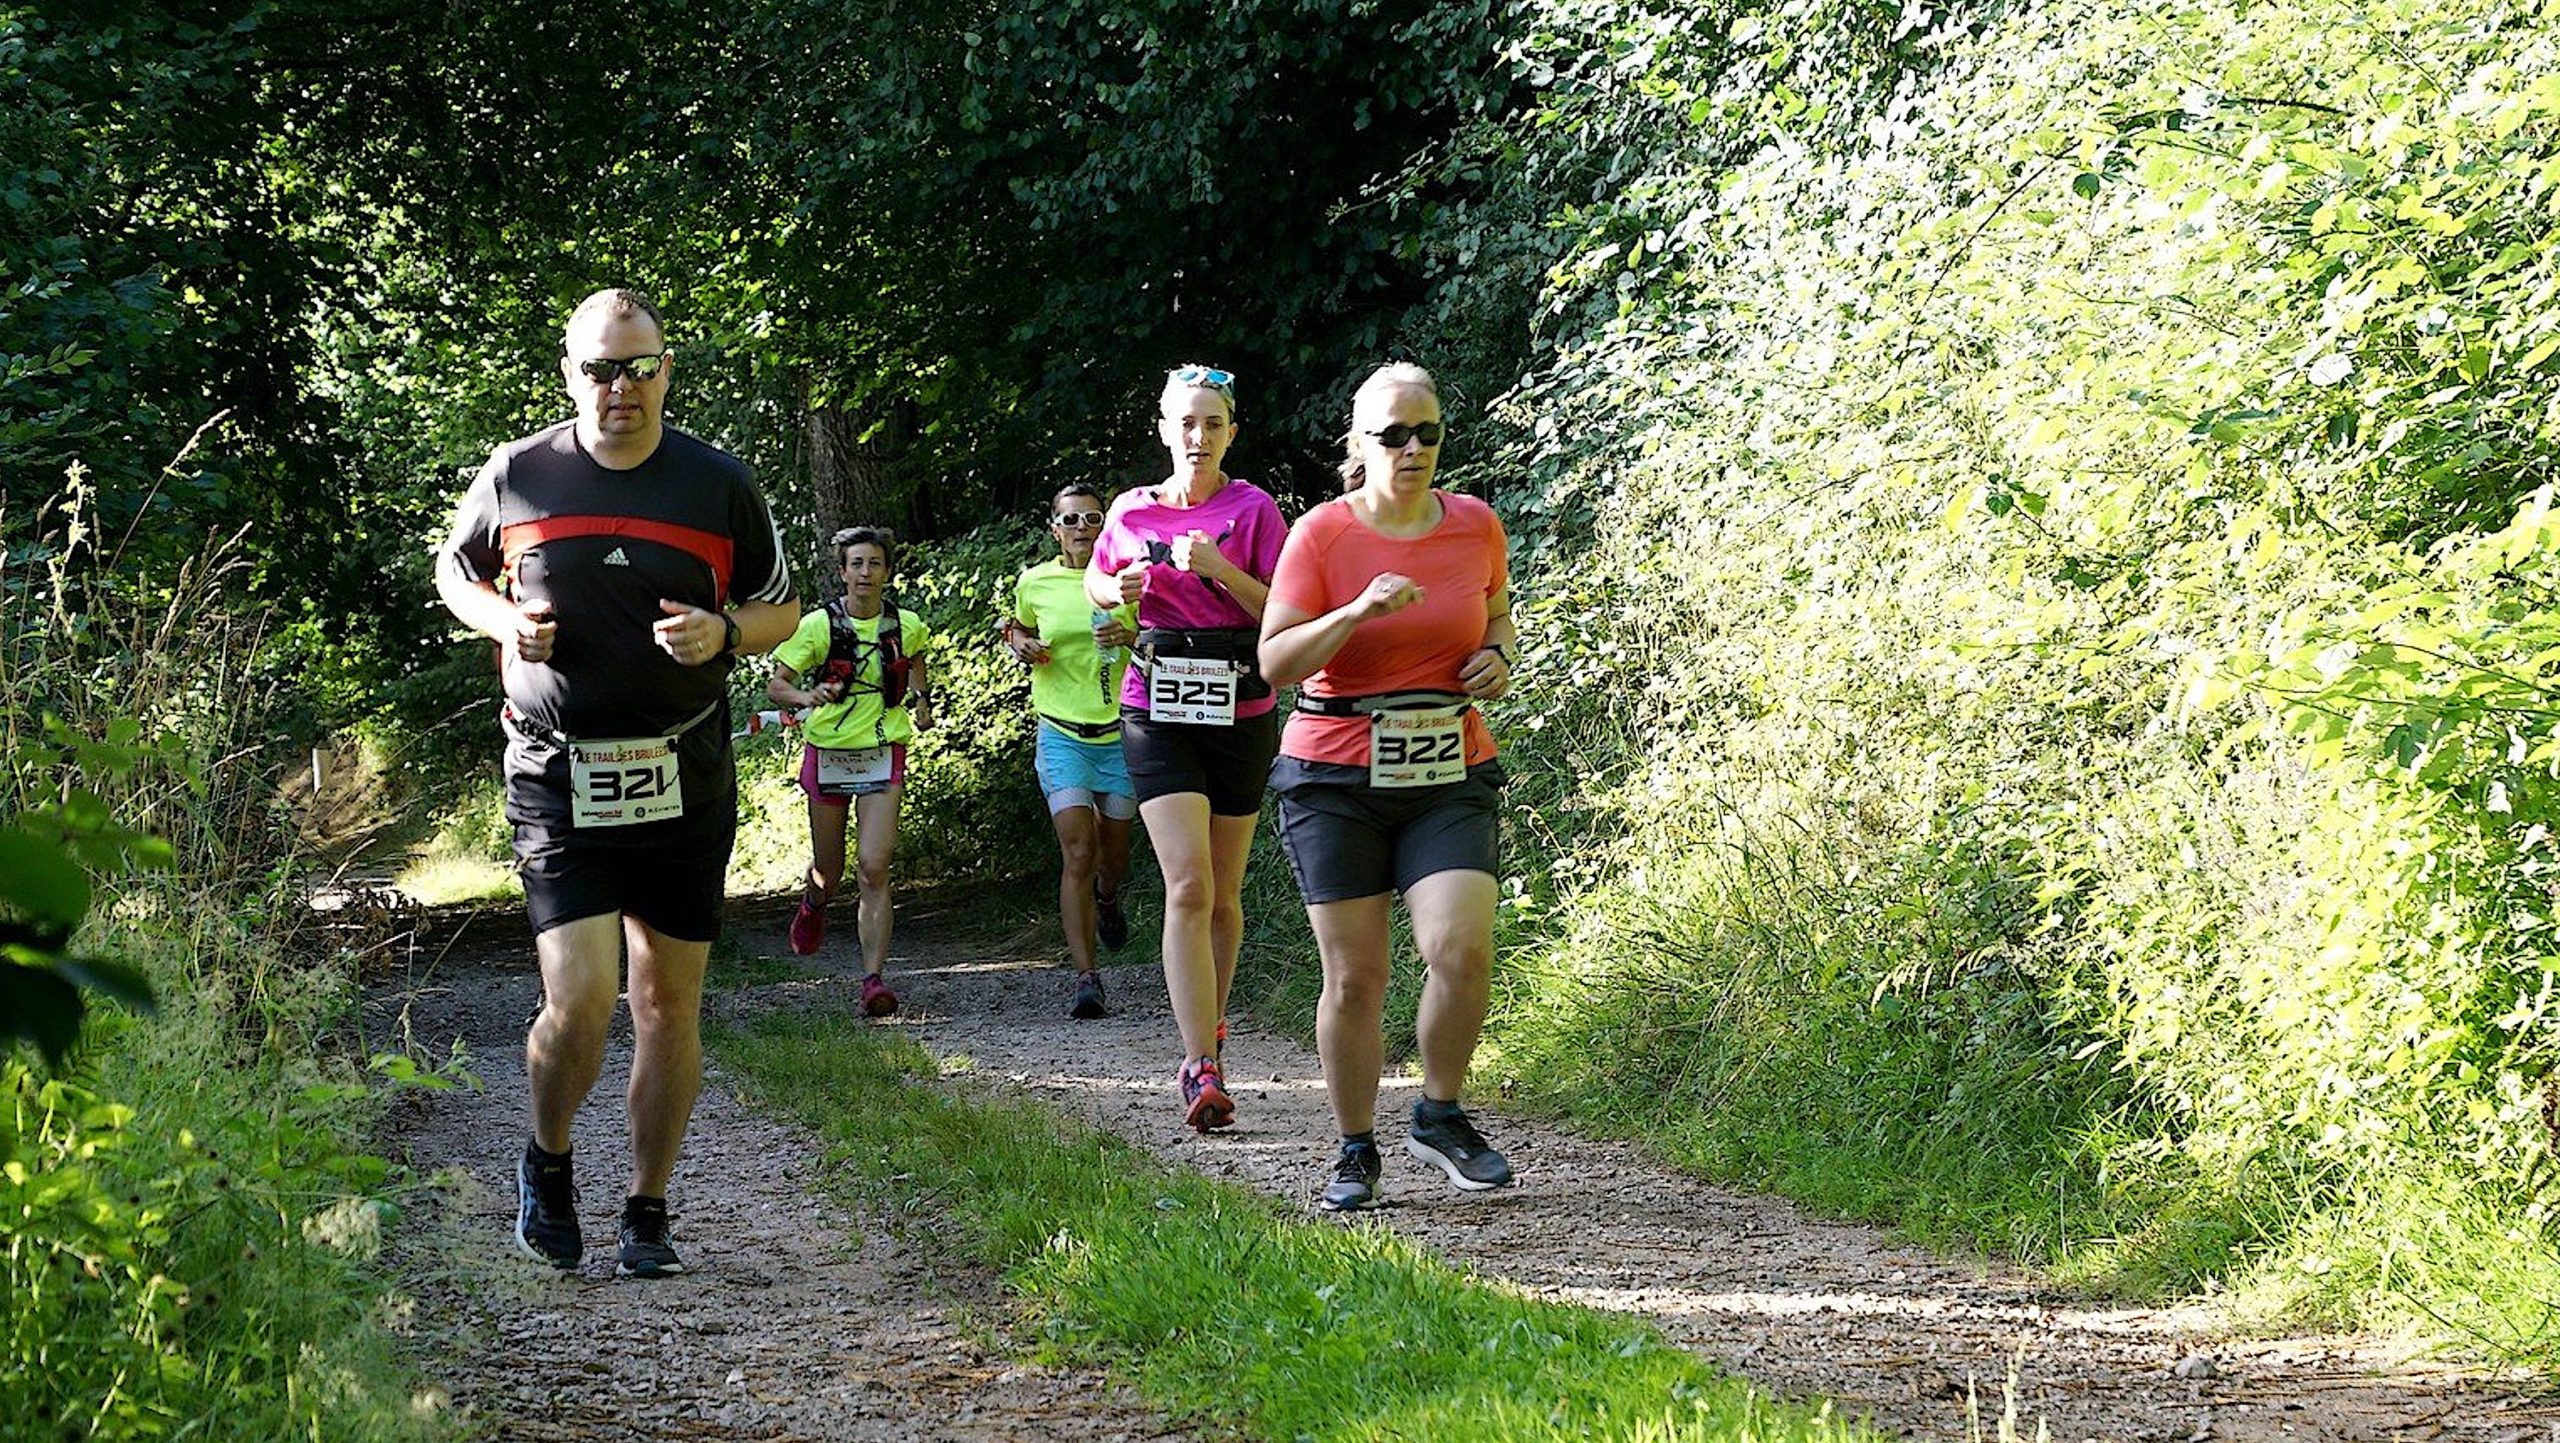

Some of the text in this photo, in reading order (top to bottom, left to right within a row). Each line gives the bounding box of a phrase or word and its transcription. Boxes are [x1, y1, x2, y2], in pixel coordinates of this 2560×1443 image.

[1156, 680, 1230, 706] 325
[581, 750, 591, 763] LE
[593, 751, 615, 763] TRAIL
[1378, 733, 1460, 765] 322
[589, 765, 665, 802] 321
